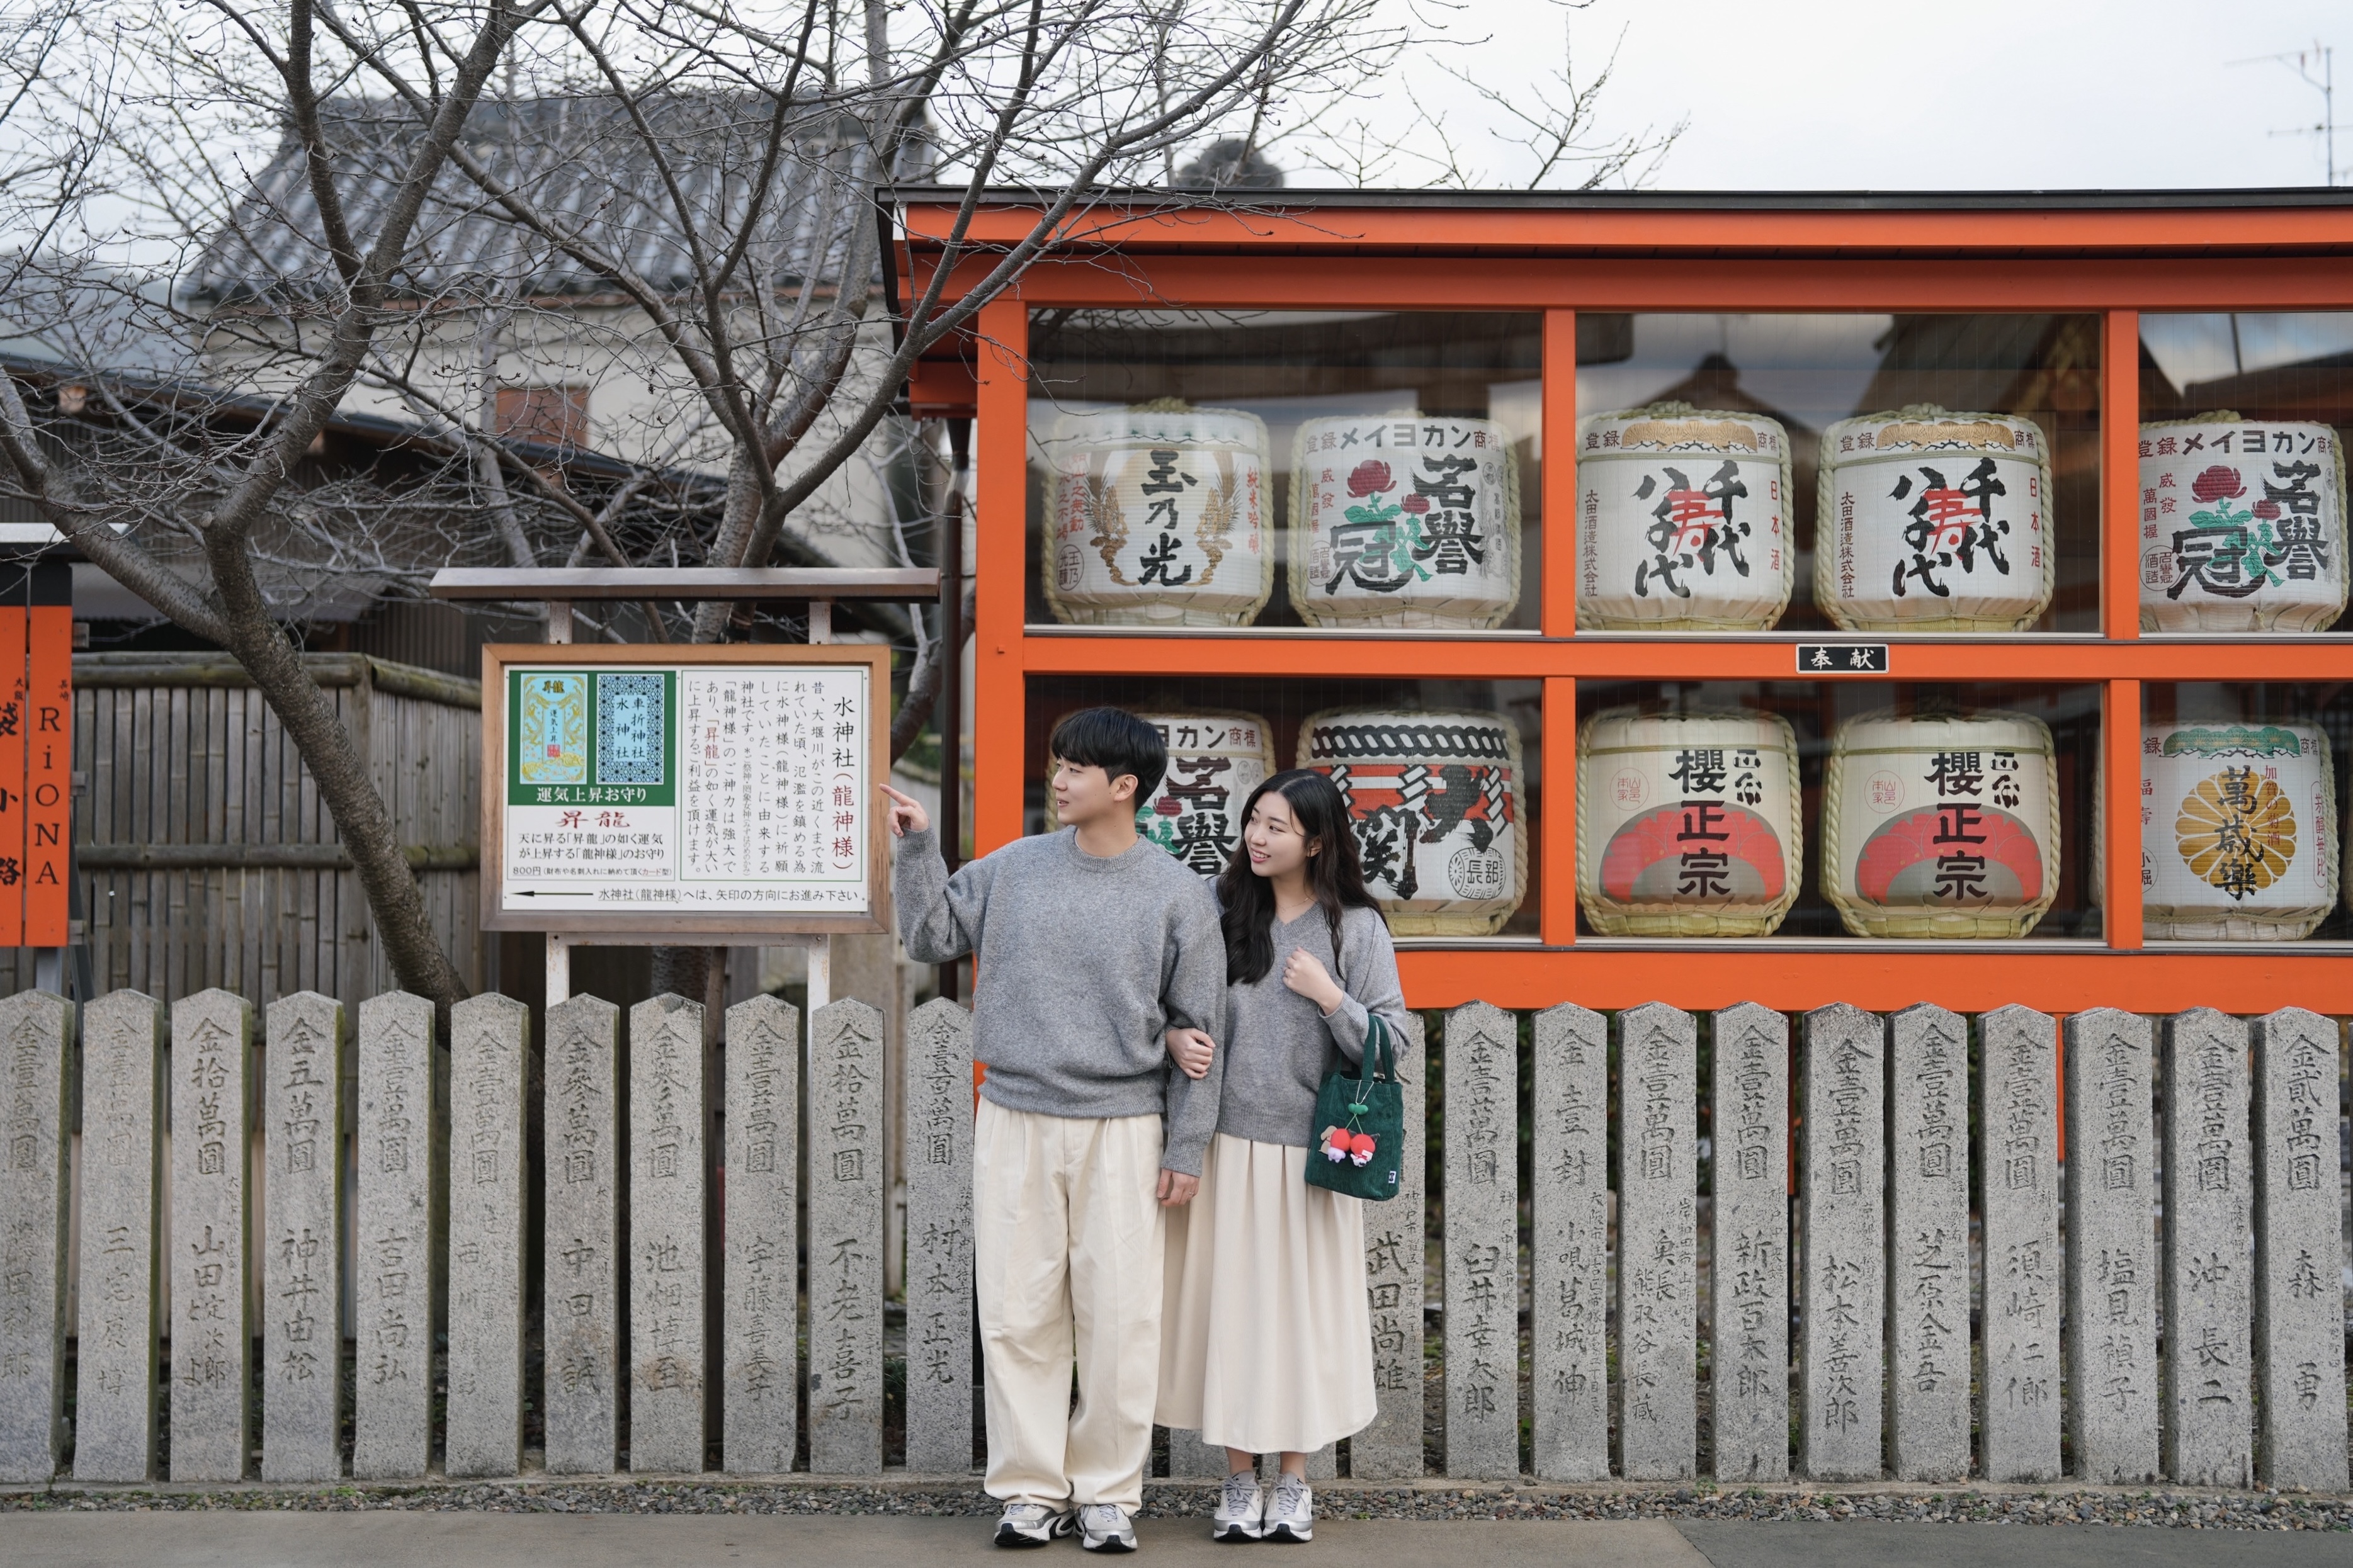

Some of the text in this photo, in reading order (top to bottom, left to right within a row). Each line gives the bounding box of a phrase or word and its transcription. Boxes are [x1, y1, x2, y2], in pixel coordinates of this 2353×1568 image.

[1341, 424, 1471, 450] メイヨカン
[1585, 430, 1621, 451] 登録
[1840, 432, 1875, 454] 登録
[2182, 430, 2316, 456] メイヨカン
[1137, 449, 1198, 587] 玉乃光
[1582, 489, 1599, 597] 太田酒造株式会社
[1770, 480, 1780, 571] 日本酒
[1839, 492, 1856, 599] 太田酒造株式会社
[2029, 477, 2041, 567] 日本酒
[1810, 646, 1875, 670] 奉献
[615, 697, 630, 759] 水神社
[631, 697, 646, 759] 車折神社
[1228, 726, 1256, 748] 商標
[35, 706, 61, 885] RiONA
[536, 787, 647, 803] 運気上昇お守り
[758, 680, 772, 873] していたことに由来する
[2264, 765, 2281, 847] 加賀の菊酒
[1668, 749, 1731, 898] 櫻正宗
[1924, 752, 1988, 901] 櫻正宗
[513, 867, 541, 876] 800円
